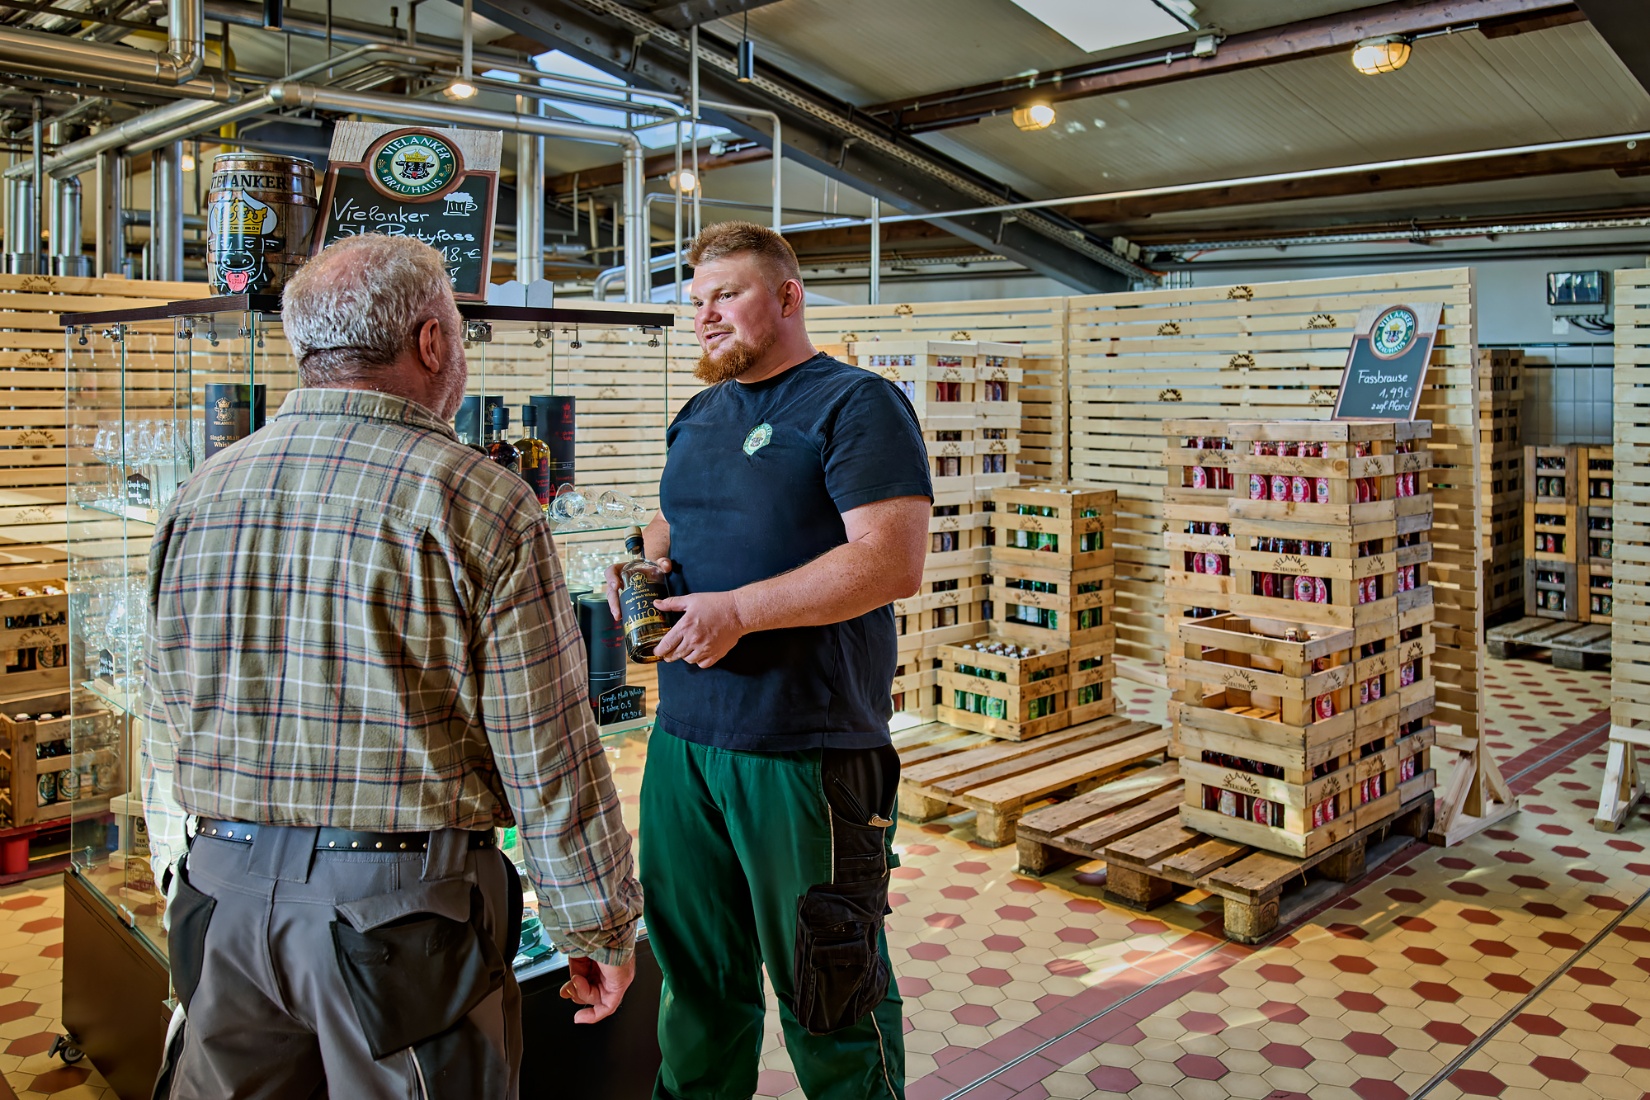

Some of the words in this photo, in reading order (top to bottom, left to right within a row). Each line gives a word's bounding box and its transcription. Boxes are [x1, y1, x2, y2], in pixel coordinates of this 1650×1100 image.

[382, 136, 451, 160] VIELANKER
[382, 175, 443, 193] BRAUHAUS
[333, 197, 430, 223] Vielanker
[1358, 369, 1408, 384] Fassbrause
[1272, 554, 1309, 575] VIELANKER
[636, 600, 649, 610] 12
[1220, 669, 1258, 691] VIELANKER
[1222, 772, 1260, 795] VIELANKER
